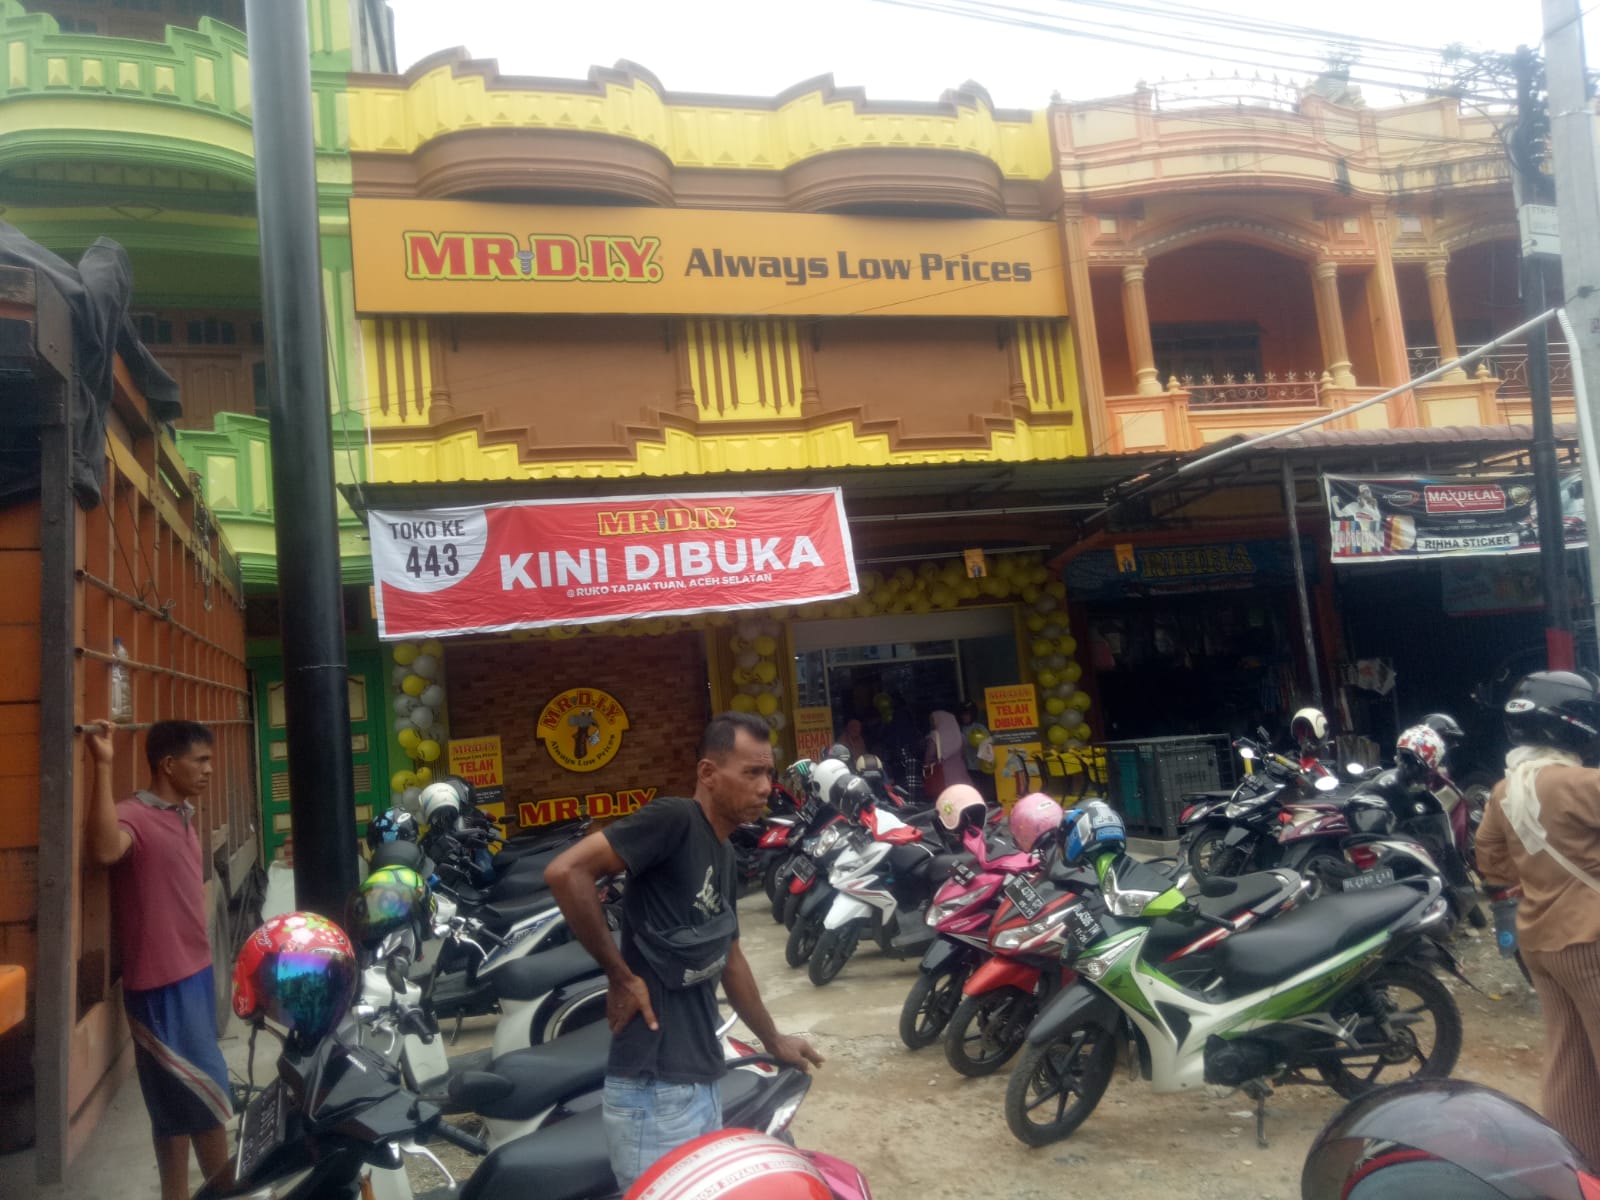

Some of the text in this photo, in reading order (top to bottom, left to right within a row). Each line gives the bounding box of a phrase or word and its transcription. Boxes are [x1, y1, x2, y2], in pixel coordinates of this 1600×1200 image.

[684, 247, 829, 286] Always
[837, 250, 911, 280] Low
[919, 252, 1032, 282] Prices
[1428, 489, 1501, 507] MAXDECAL
[389, 519, 466, 540] TOKO KE
[1463, 535, 1512, 548] STICKER
[406, 543, 460, 579] 443
[499, 535, 825, 591] KINI DIBUKA
[611, 582, 651, 594] TAPAK
[689, 575, 720, 587] ACEH
[721, 572, 773, 585] SELATAN
[459, 759, 494, 774] TELAH
